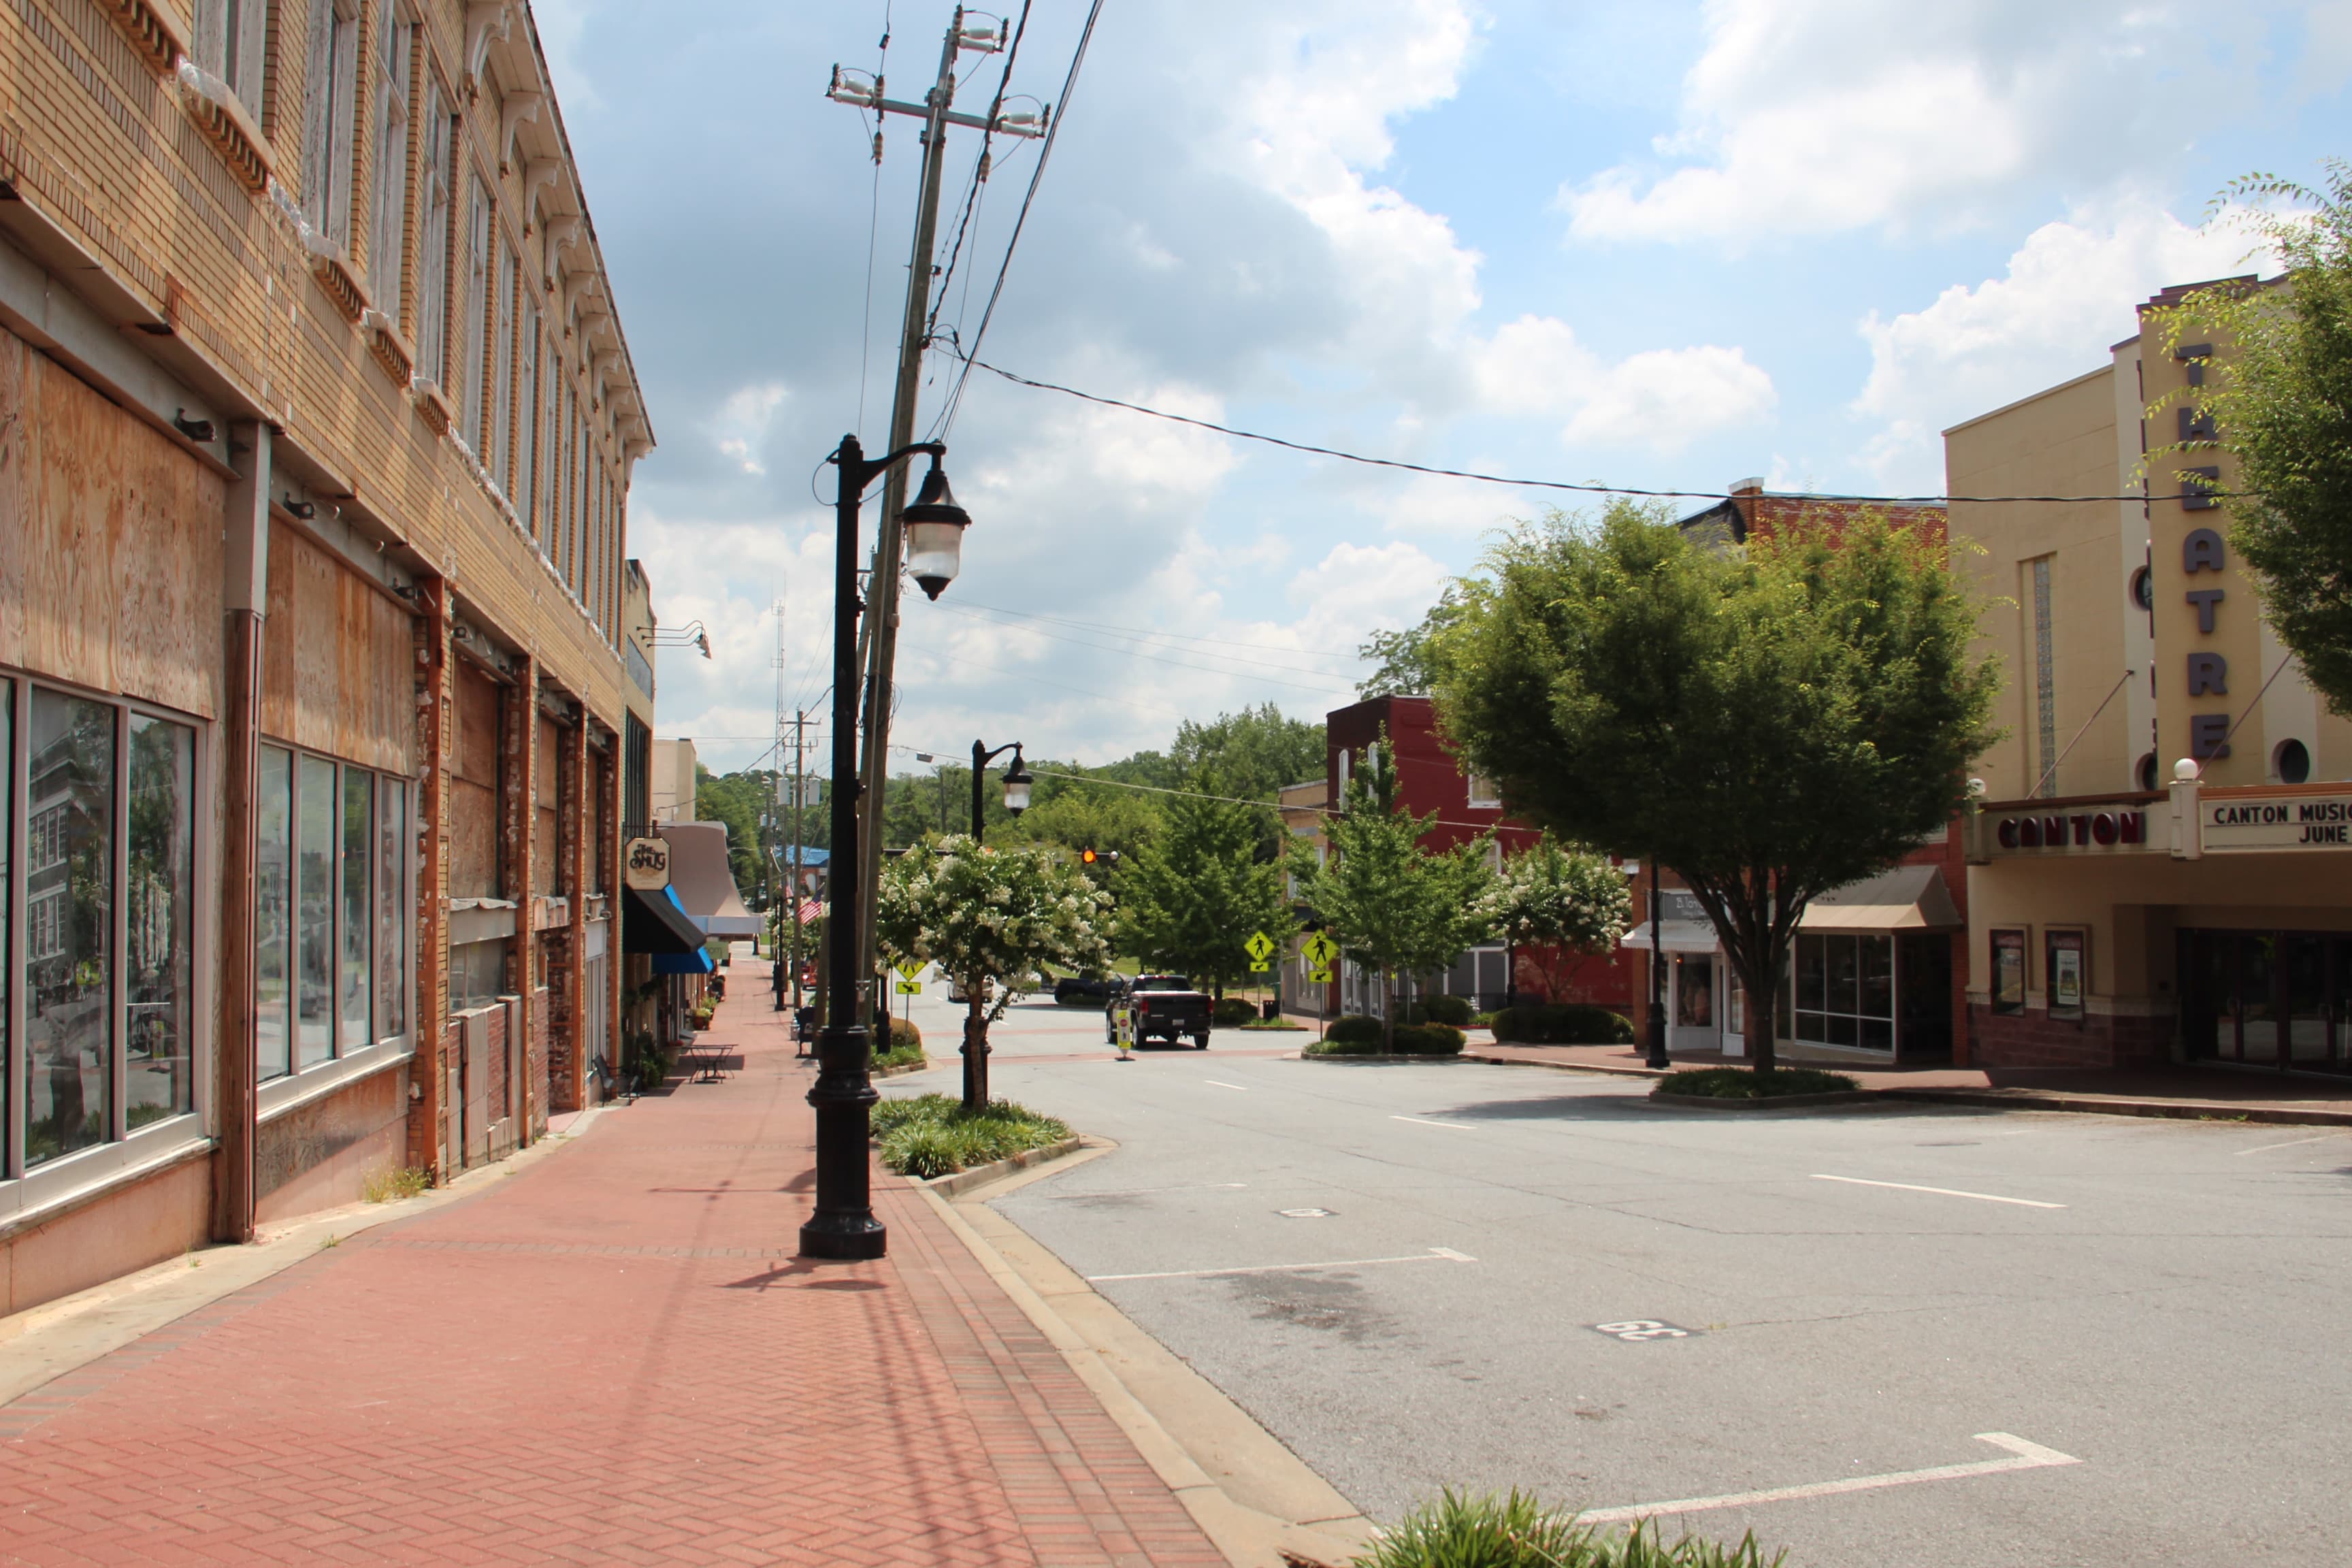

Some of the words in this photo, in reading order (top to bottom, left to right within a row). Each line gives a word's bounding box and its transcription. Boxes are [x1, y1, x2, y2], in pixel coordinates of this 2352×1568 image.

[2174, 343, 2230, 759] THEATRE
[2215, 804, 2288, 825] CANTON
[1998, 811, 2146, 849] CANTON
[2299, 825, 2347, 844] JUNE
